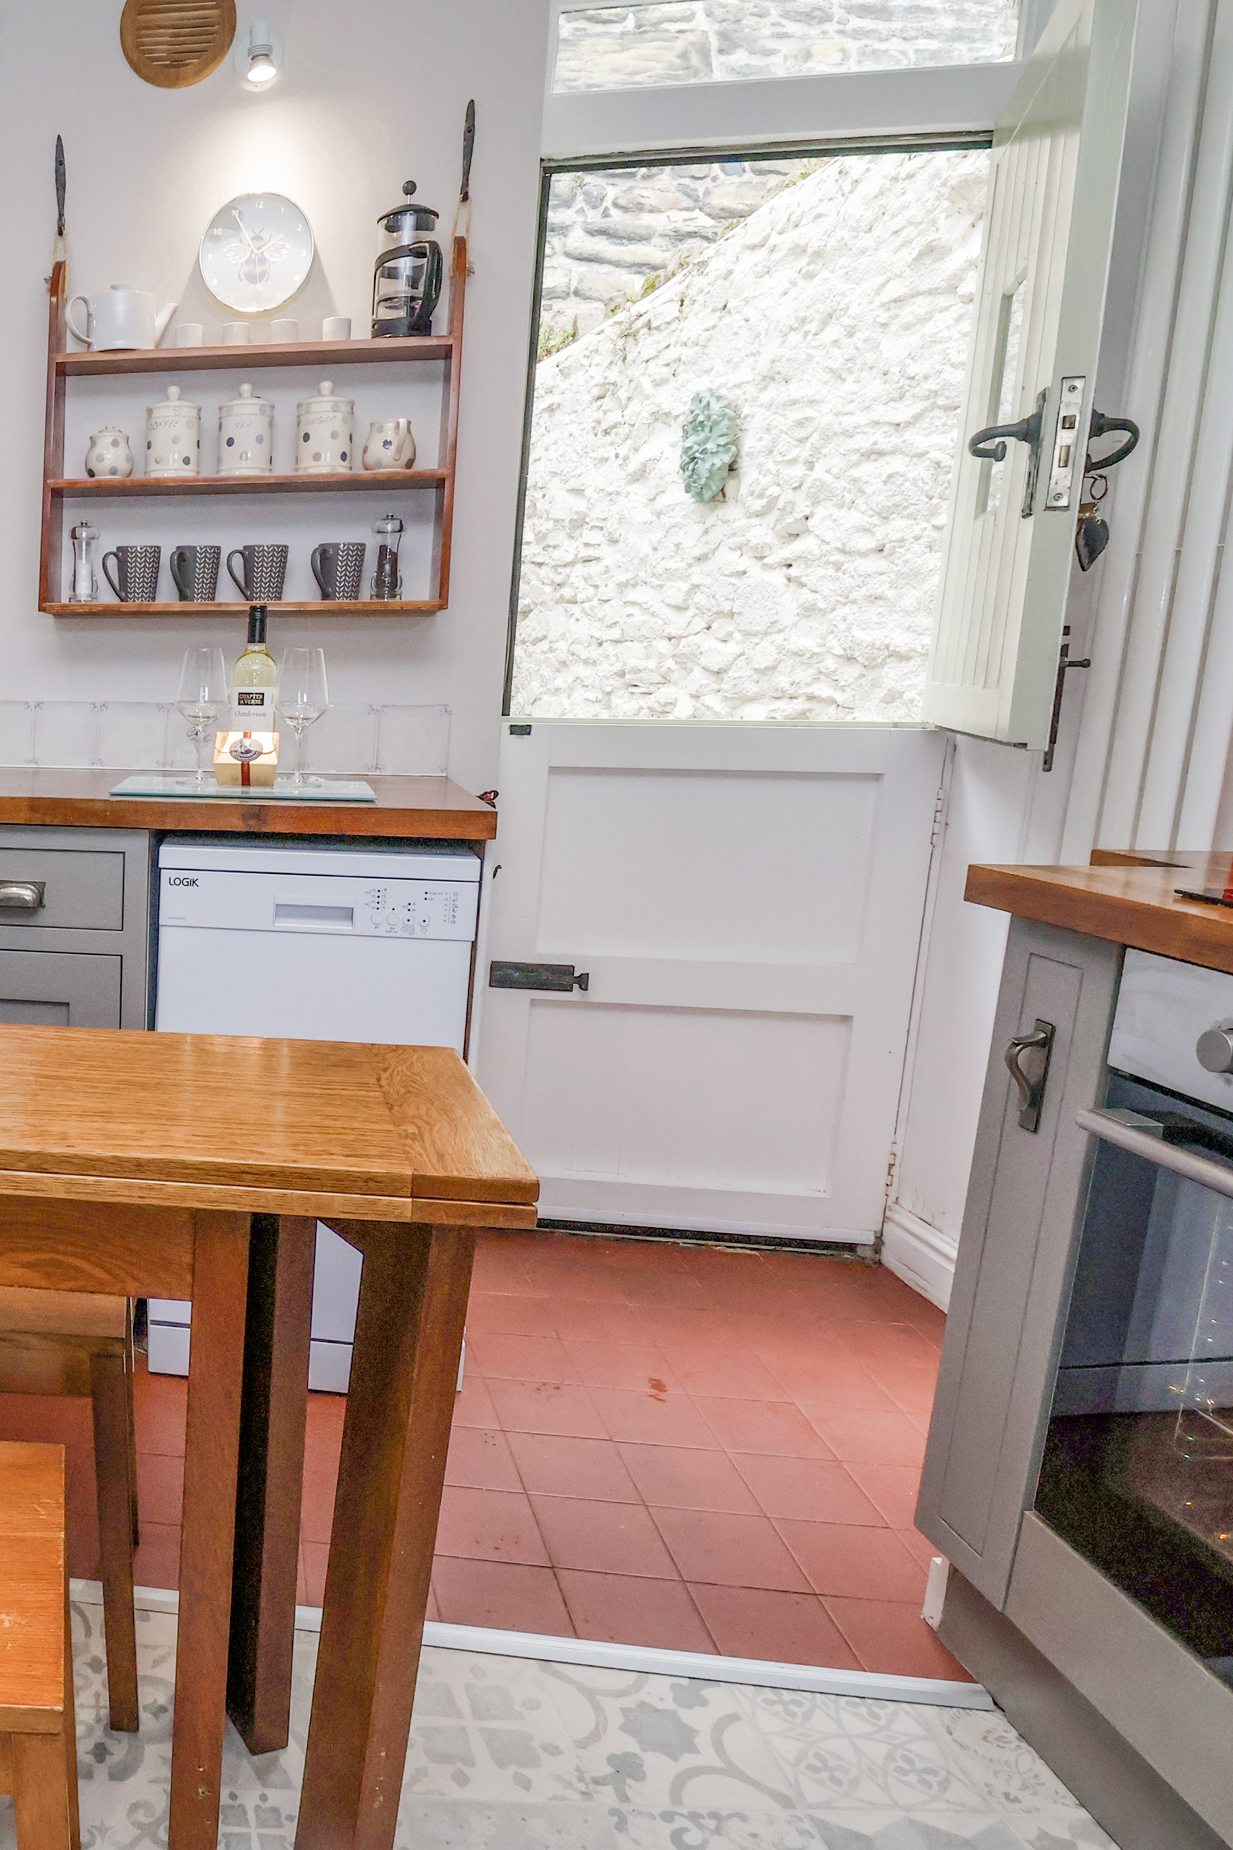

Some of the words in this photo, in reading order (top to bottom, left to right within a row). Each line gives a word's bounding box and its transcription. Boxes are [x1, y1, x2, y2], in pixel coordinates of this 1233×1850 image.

[255, 201, 264, 209] 12
[297, 224, 303, 232] 2
[168, 877, 199, 887] LOGIK
